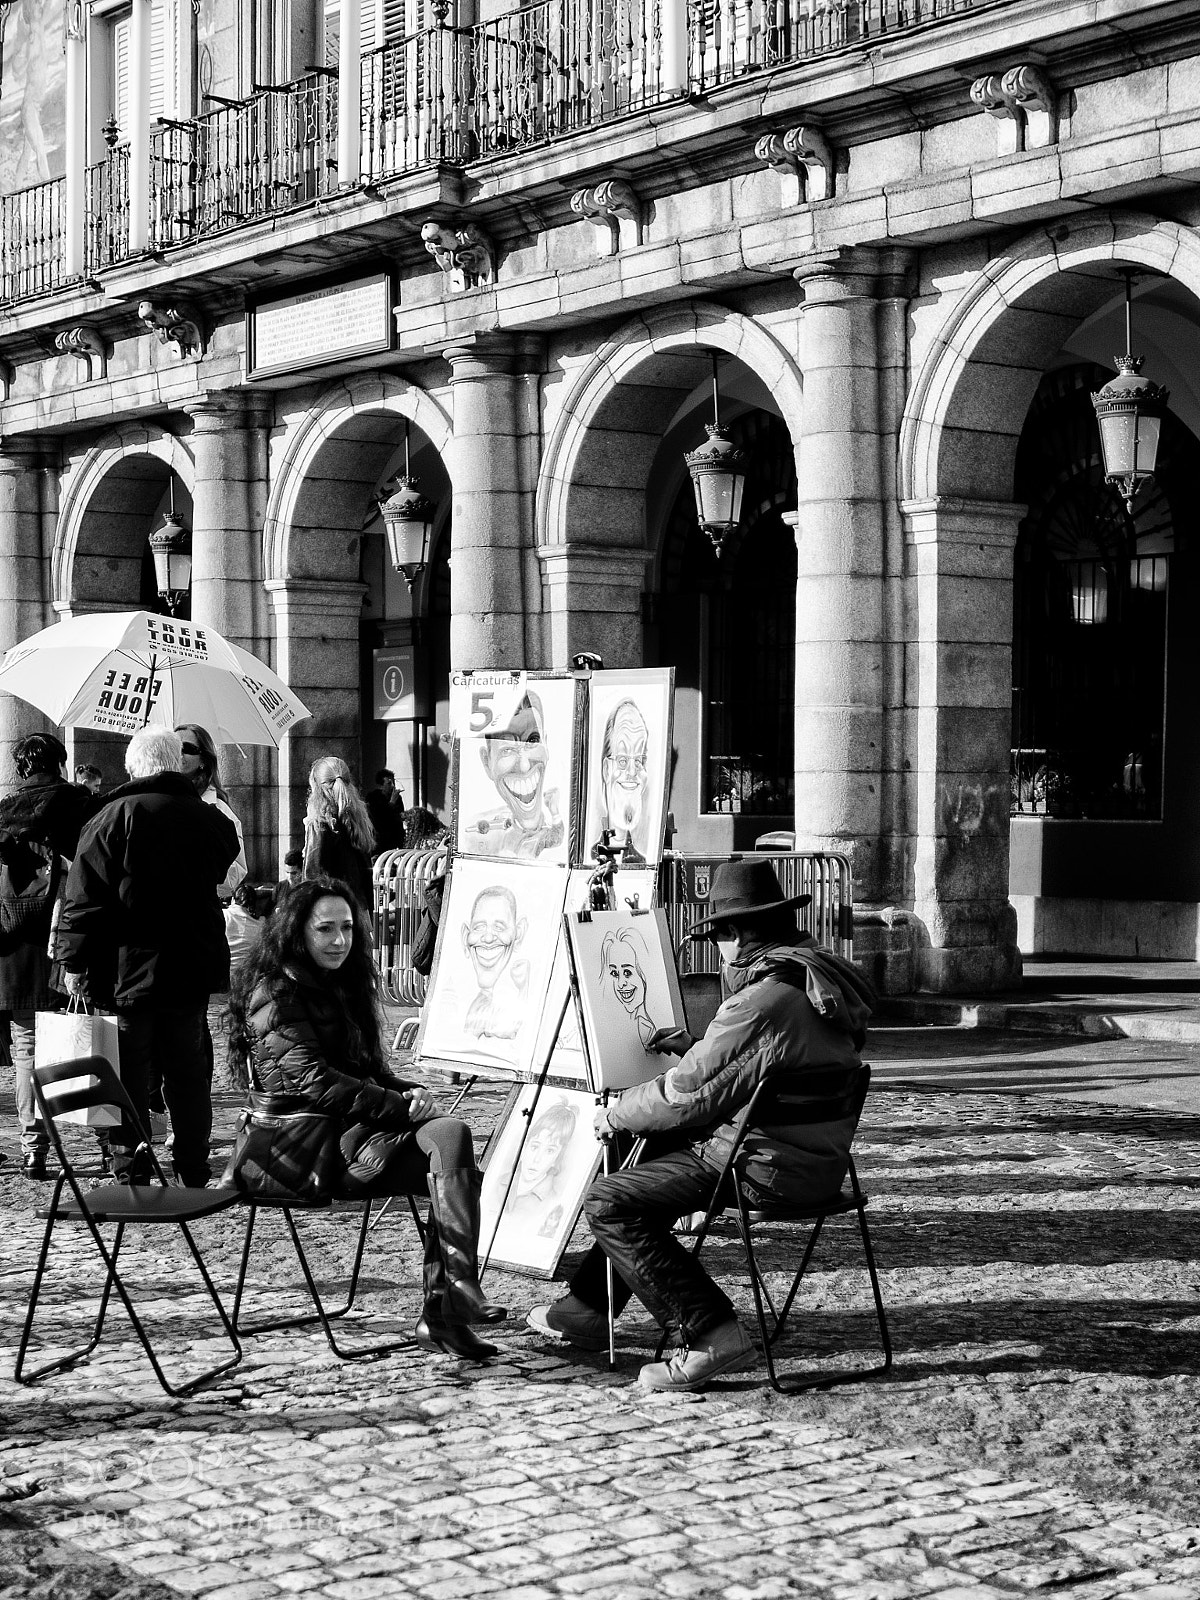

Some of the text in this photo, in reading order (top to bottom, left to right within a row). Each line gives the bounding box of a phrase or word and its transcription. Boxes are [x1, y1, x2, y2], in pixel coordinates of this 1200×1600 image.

[147, 618, 206, 640] FREE
[147, 628, 207, 651] TOUR
[452, 675, 520, 686] Caricaturas
